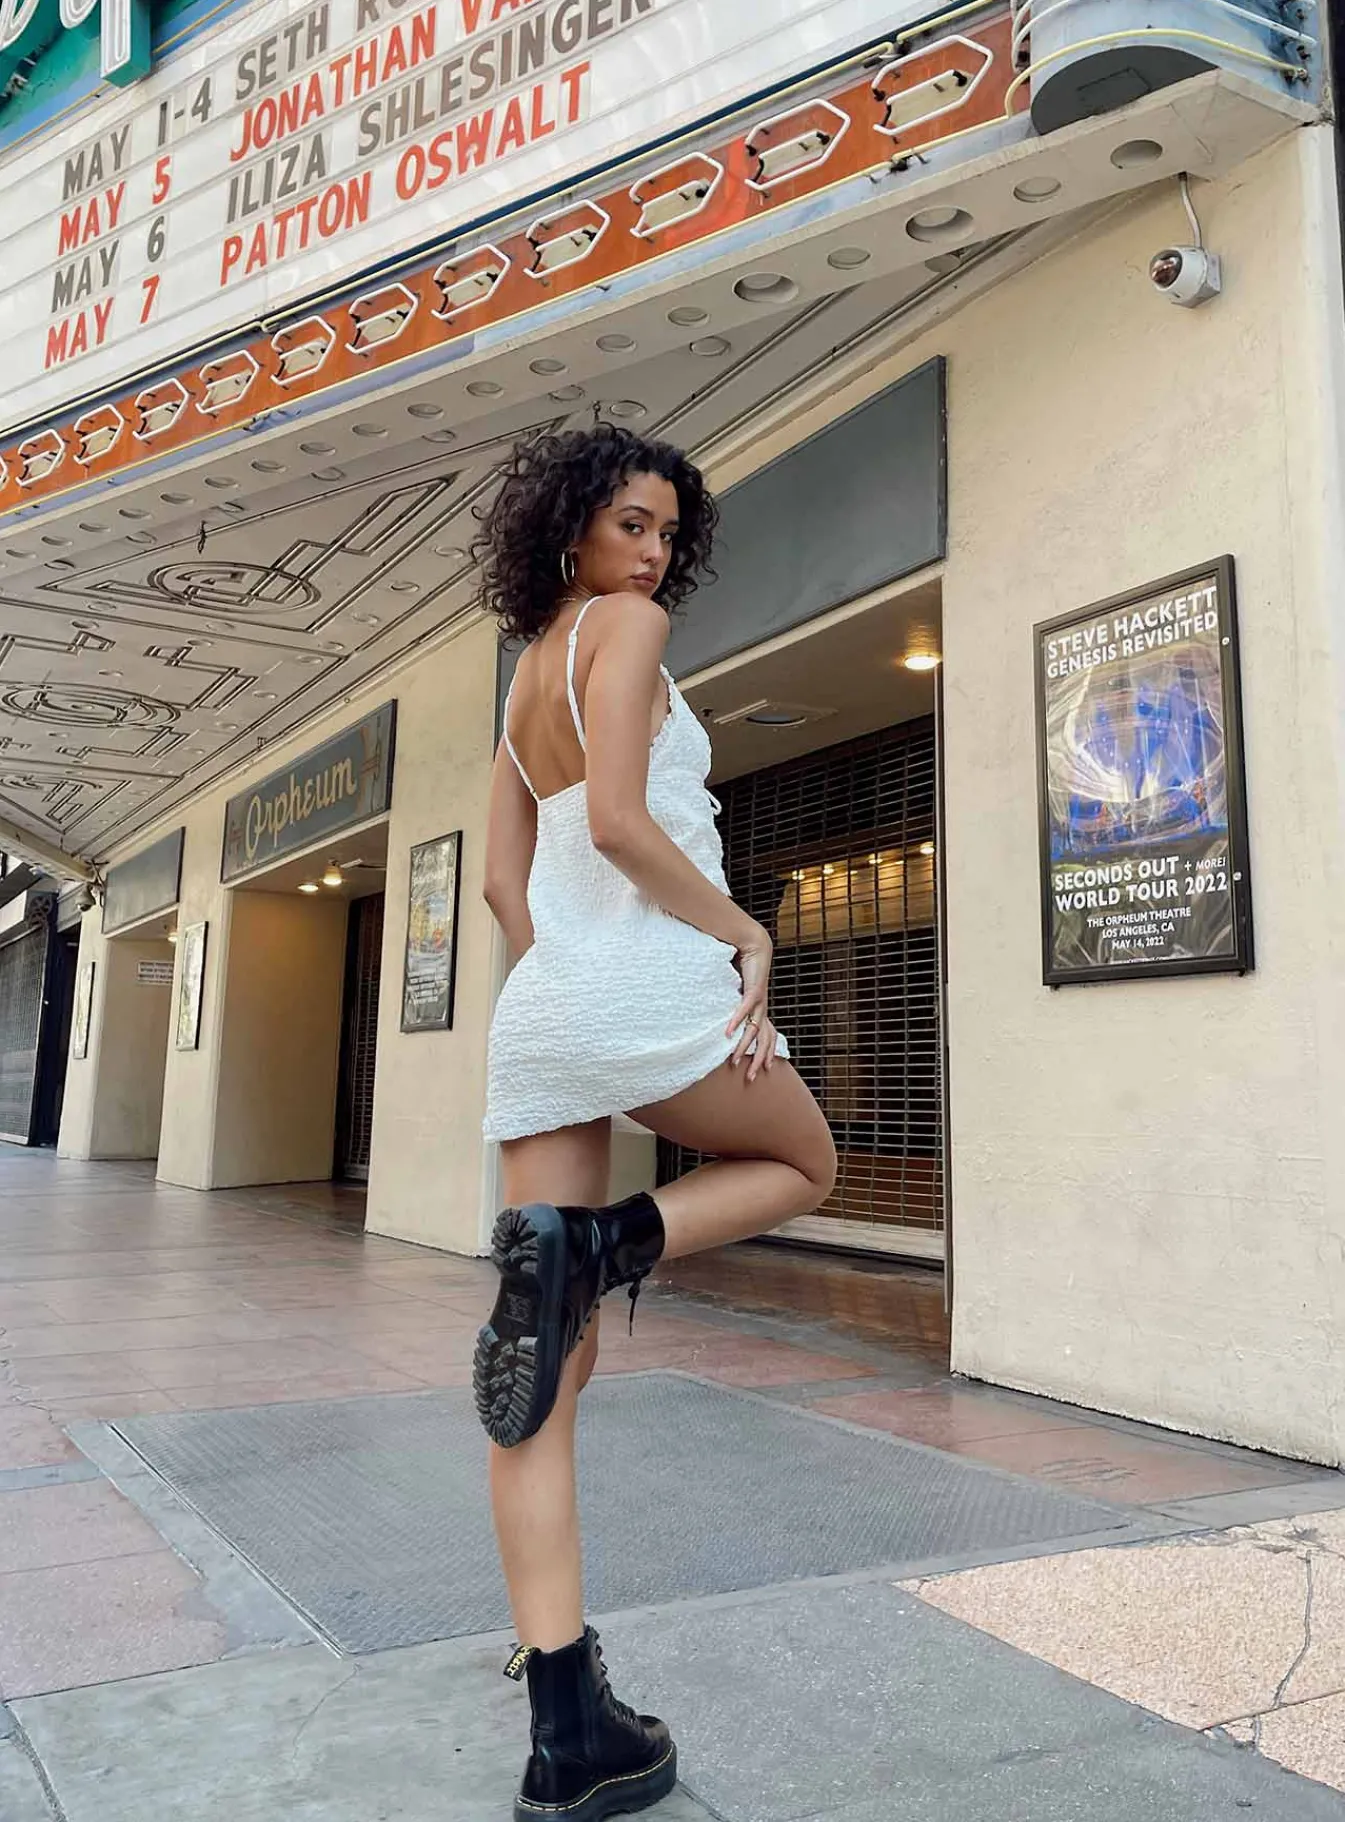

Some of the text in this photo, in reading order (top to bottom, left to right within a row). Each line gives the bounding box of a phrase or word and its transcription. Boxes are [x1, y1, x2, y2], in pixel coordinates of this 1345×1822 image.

[58, 180, 126, 256] MAY
[152, 155, 171, 204] 5
[231, 6, 436, 162] JONATHAN
[63, 124, 130, 200] MAY
[236, 4, 329, 100] SETH
[44, 61, 590, 369] MAY 7 PATTON OSWALT
[51, 238, 119, 313] MAY
[147, 215, 165, 263] 6
[226, 132, 326, 224] ILIZA
[1047, 585, 1217, 660] STEVE HACKETT
[1047, 611, 1218, 679] GENESIS REVISITED
[245, 757, 357, 859] Orpheum
[1055, 863, 1132, 892] SECONDS
[1138, 856, 1179, 879] OUT
[1195, 857, 1226, 871] MORE!
[1055, 872, 1228, 912] WORLD TOUR 2022
[1087, 907, 1192, 929] THE ORPHEUM THEATRE
[1102, 922, 1175, 939] LOS ANGELES, CA
[1112, 938, 1131, 950] MAY
[1146, 935, 1165, 947] 2022
